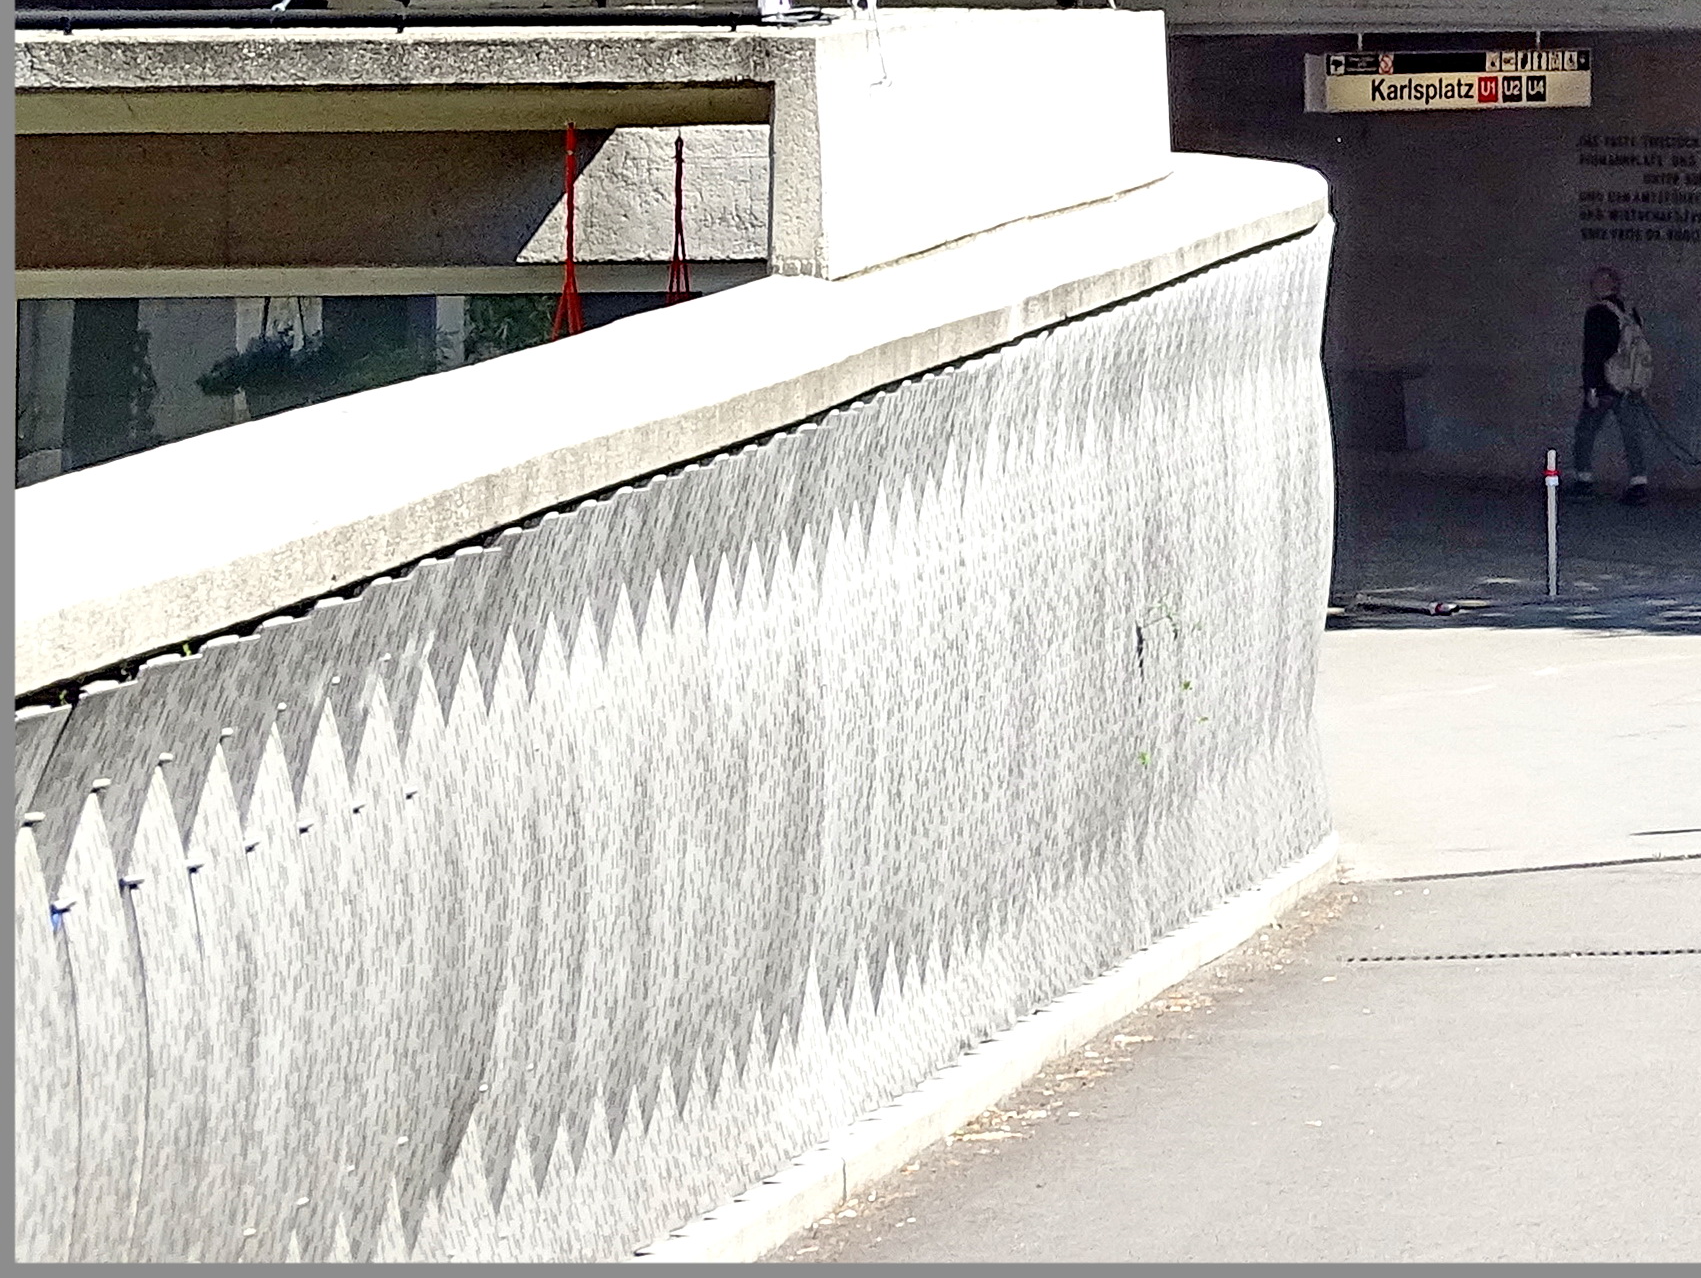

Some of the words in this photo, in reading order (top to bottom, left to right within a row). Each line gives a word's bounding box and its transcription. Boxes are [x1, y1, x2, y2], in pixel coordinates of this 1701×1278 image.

[1371, 77, 1474, 105] Karlsplatz
[1480, 81, 1496, 96] U1
[1504, 80, 1521, 96] U2
[1528, 79, 1546, 95] U4
